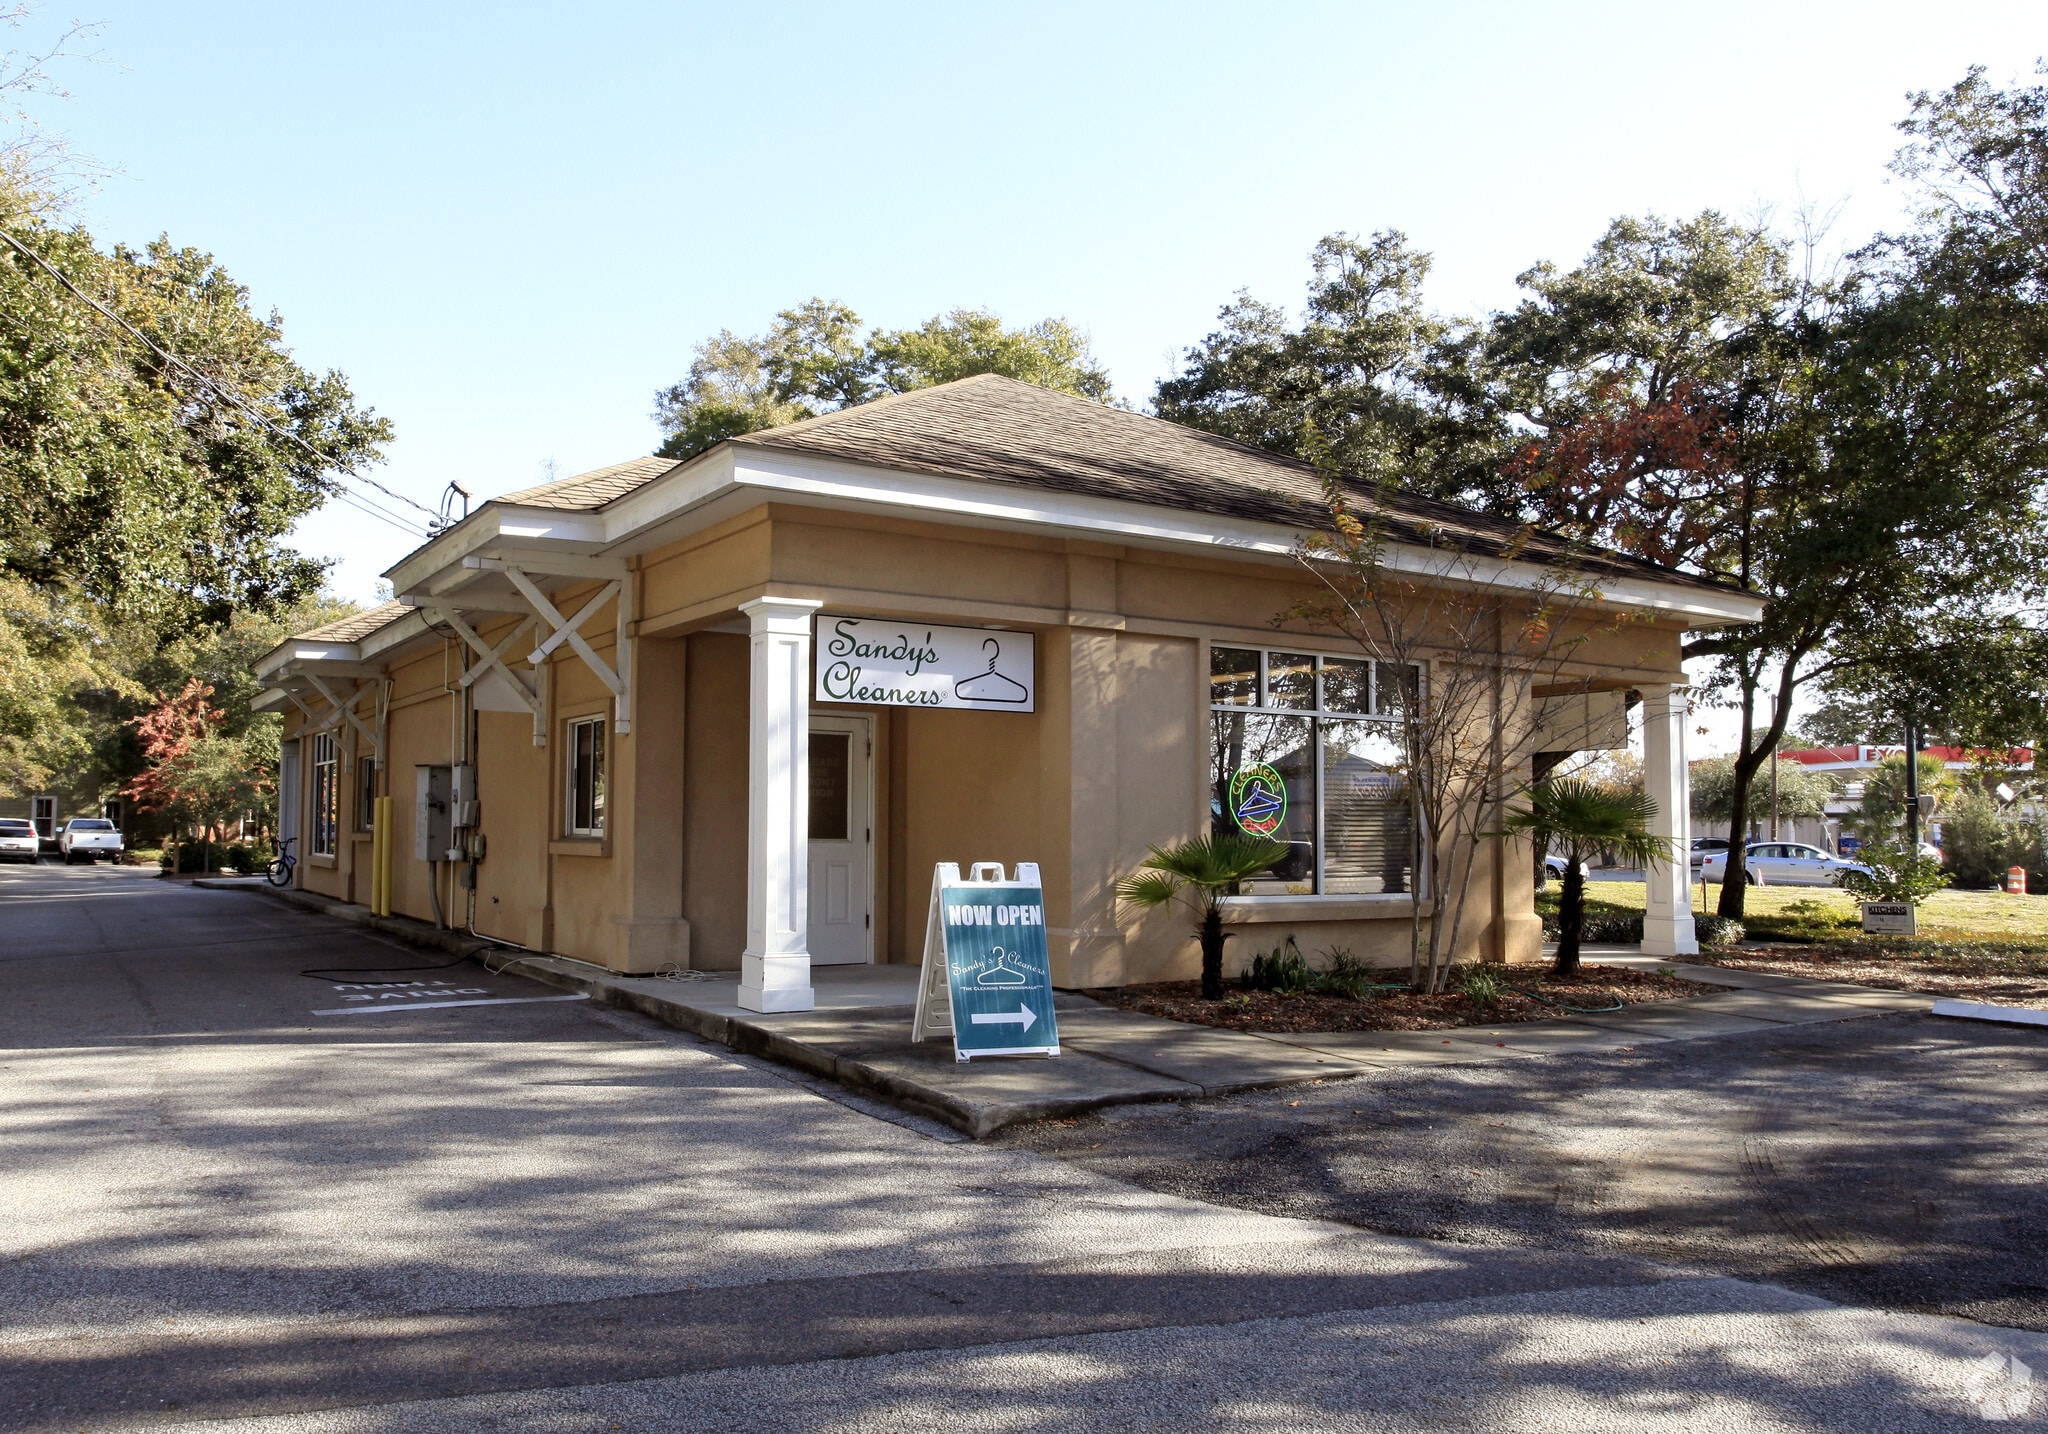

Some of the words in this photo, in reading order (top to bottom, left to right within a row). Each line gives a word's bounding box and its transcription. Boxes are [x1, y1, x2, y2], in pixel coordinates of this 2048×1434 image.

[828, 620, 939, 676] Sandy's
[822, 660, 943, 705] Cleaners
[1866, 749, 1907, 761] EXXO
[1233, 765, 1282, 795] CLEANERS
[1243, 817, 1277, 833] OPEN
[948, 905, 992, 926] NOW
[996, 905, 1042, 926] OPEN
[1868, 905, 1907, 915] KITCHENS
[951, 954, 994, 976] Sandy's
[1007, 951, 1045, 975] Cleaners
[332, 980, 456, 991] THRU
[340, 987, 488, 1001] DRIVE
